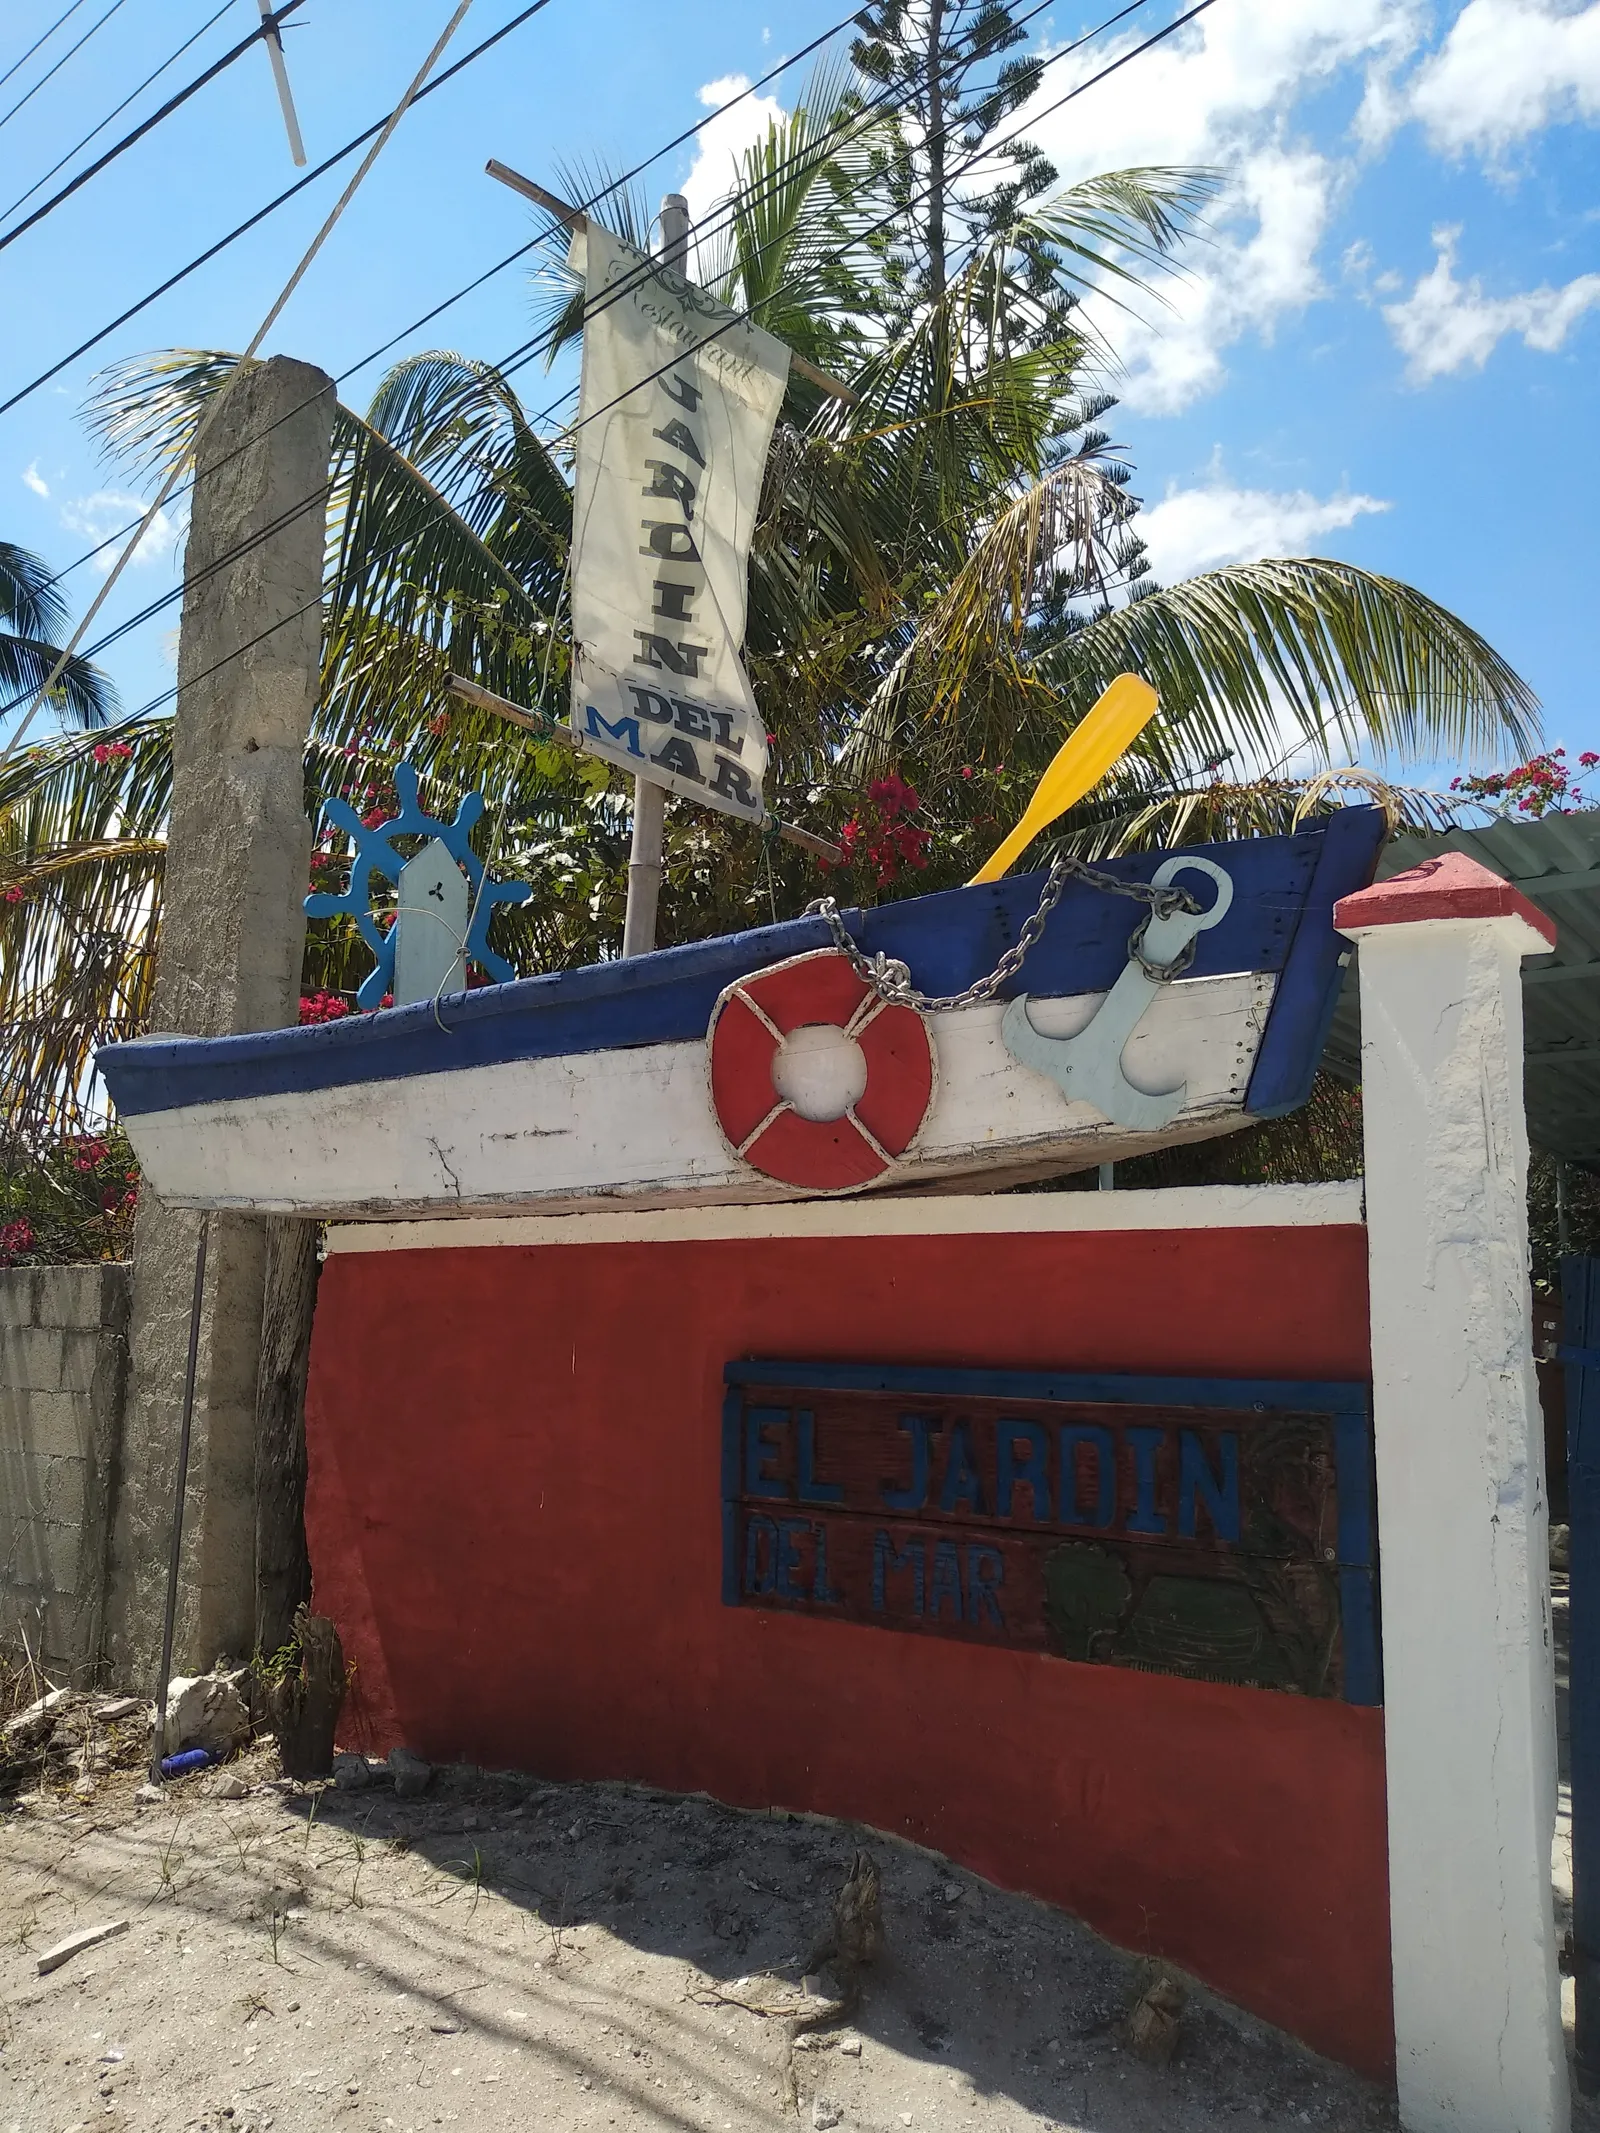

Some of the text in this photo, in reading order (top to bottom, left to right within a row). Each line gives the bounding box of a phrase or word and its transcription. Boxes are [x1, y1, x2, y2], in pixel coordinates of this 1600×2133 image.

[632, 373, 709, 679] JARDIN
[584, 705, 758, 809] MAR
[628, 685, 745, 756] DEL
[745, 1406, 1241, 1544] EL JARDIN
[745, 1515, 1006, 1629] DEL MAR
